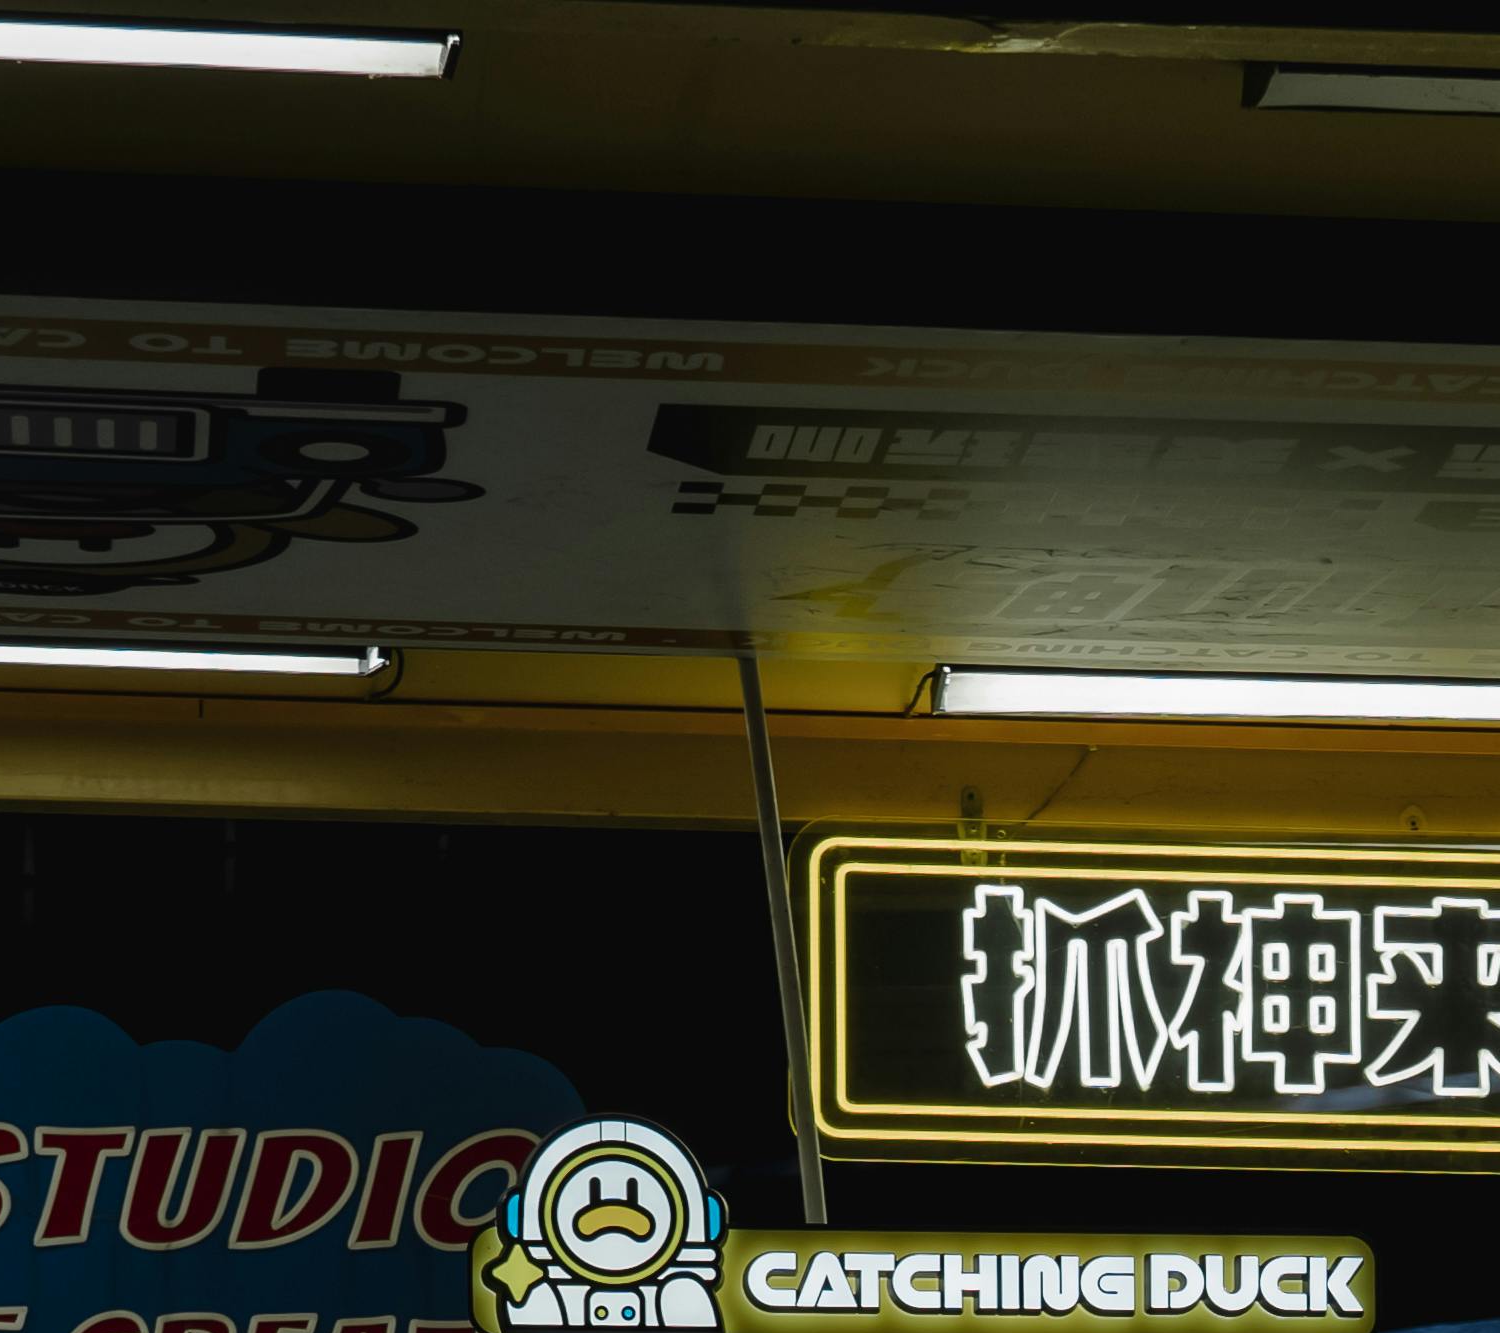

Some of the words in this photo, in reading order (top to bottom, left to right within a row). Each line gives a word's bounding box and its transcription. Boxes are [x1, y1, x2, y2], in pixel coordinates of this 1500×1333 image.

[128, 333, 243, 356] TO
[286, 336, 725, 371] WELCOME
[127, 615, 223, 630] TO
[257, 620, 628, 644] WELCOME
[746, 1250, 1137, 1313] CATCHING
[1149, 1253, 1365, 1314] DUCK
